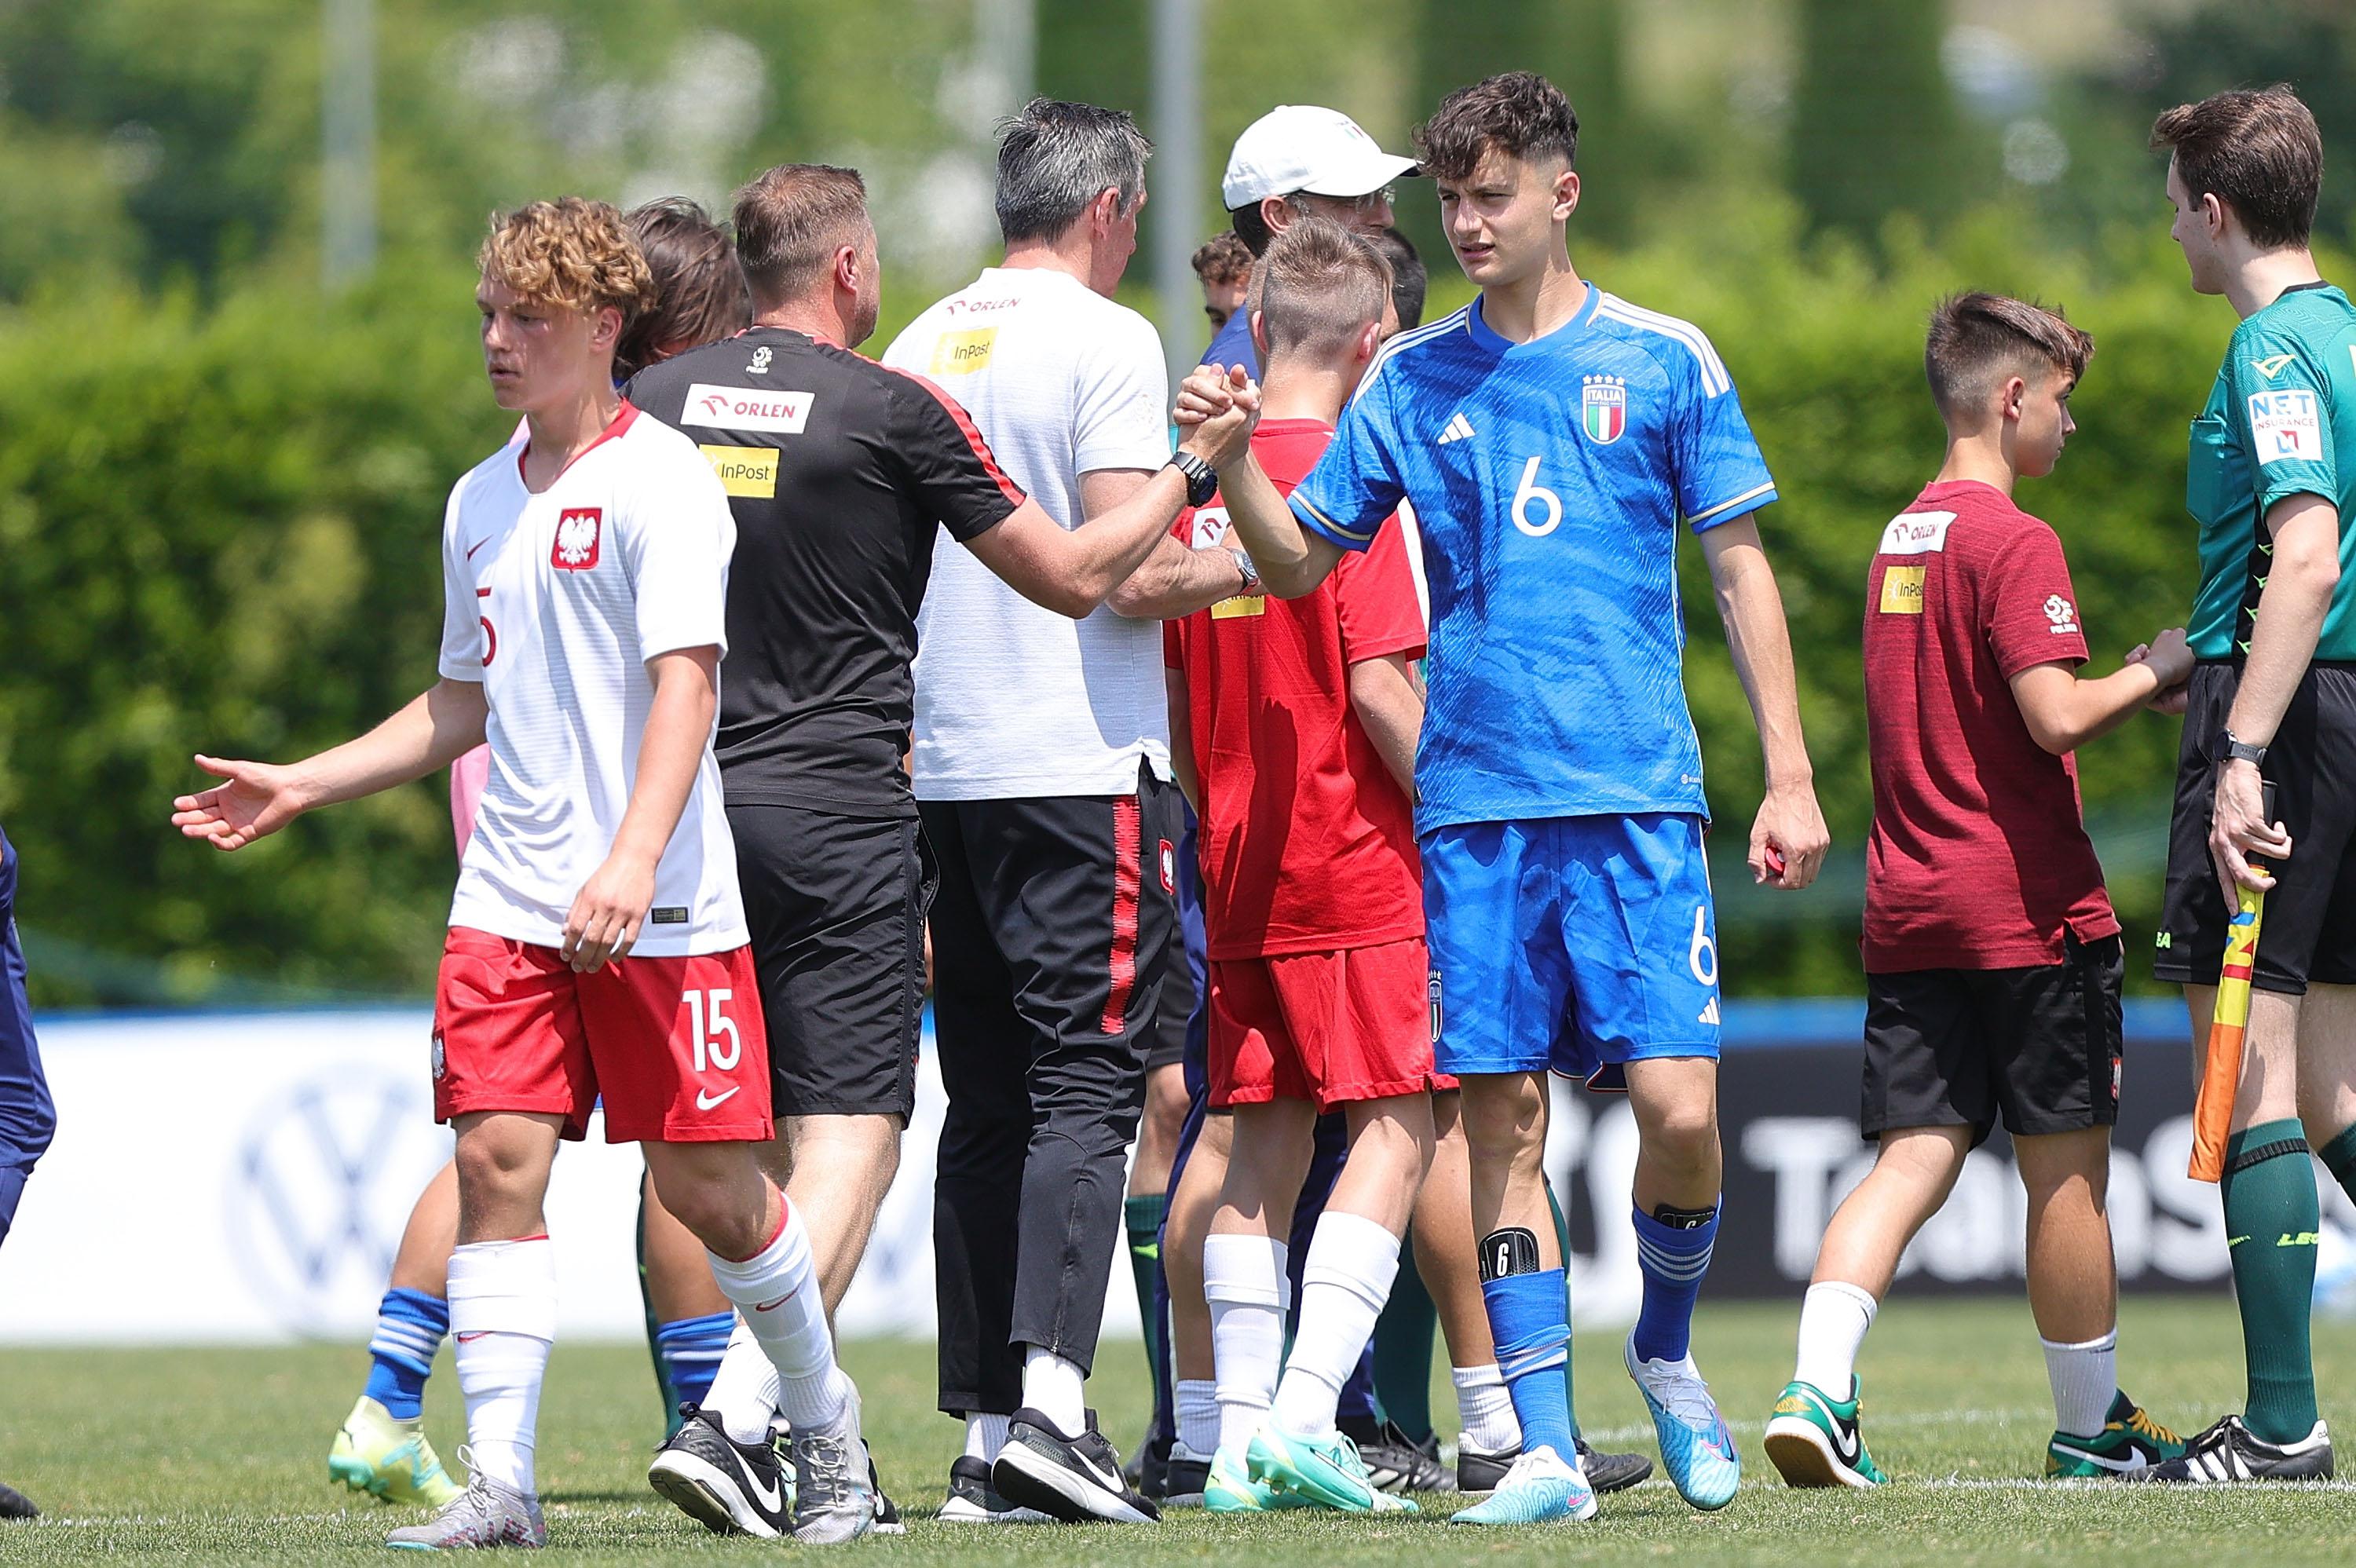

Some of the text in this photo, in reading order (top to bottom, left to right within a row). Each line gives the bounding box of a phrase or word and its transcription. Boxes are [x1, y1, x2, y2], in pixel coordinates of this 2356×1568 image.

[970, 298, 1021, 312] ORLEN
[955, 341, 990, 359] InPost
[1586, 389, 1622, 402] ITALIA
[734, 402, 796, 418] ORLEN
[2252, 395, 2310, 419] NET
[2255, 418, 2315, 431] INSURANCE
[721, 463, 770, 481] InPost
[1511, 455, 1563, 537] 6
[1900, 583, 1923, 597] InPos
[1689, 905, 1718, 986] 6
[682, 989, 741, 1072] 15
[1497, 1242, 1509, 1277] 6
